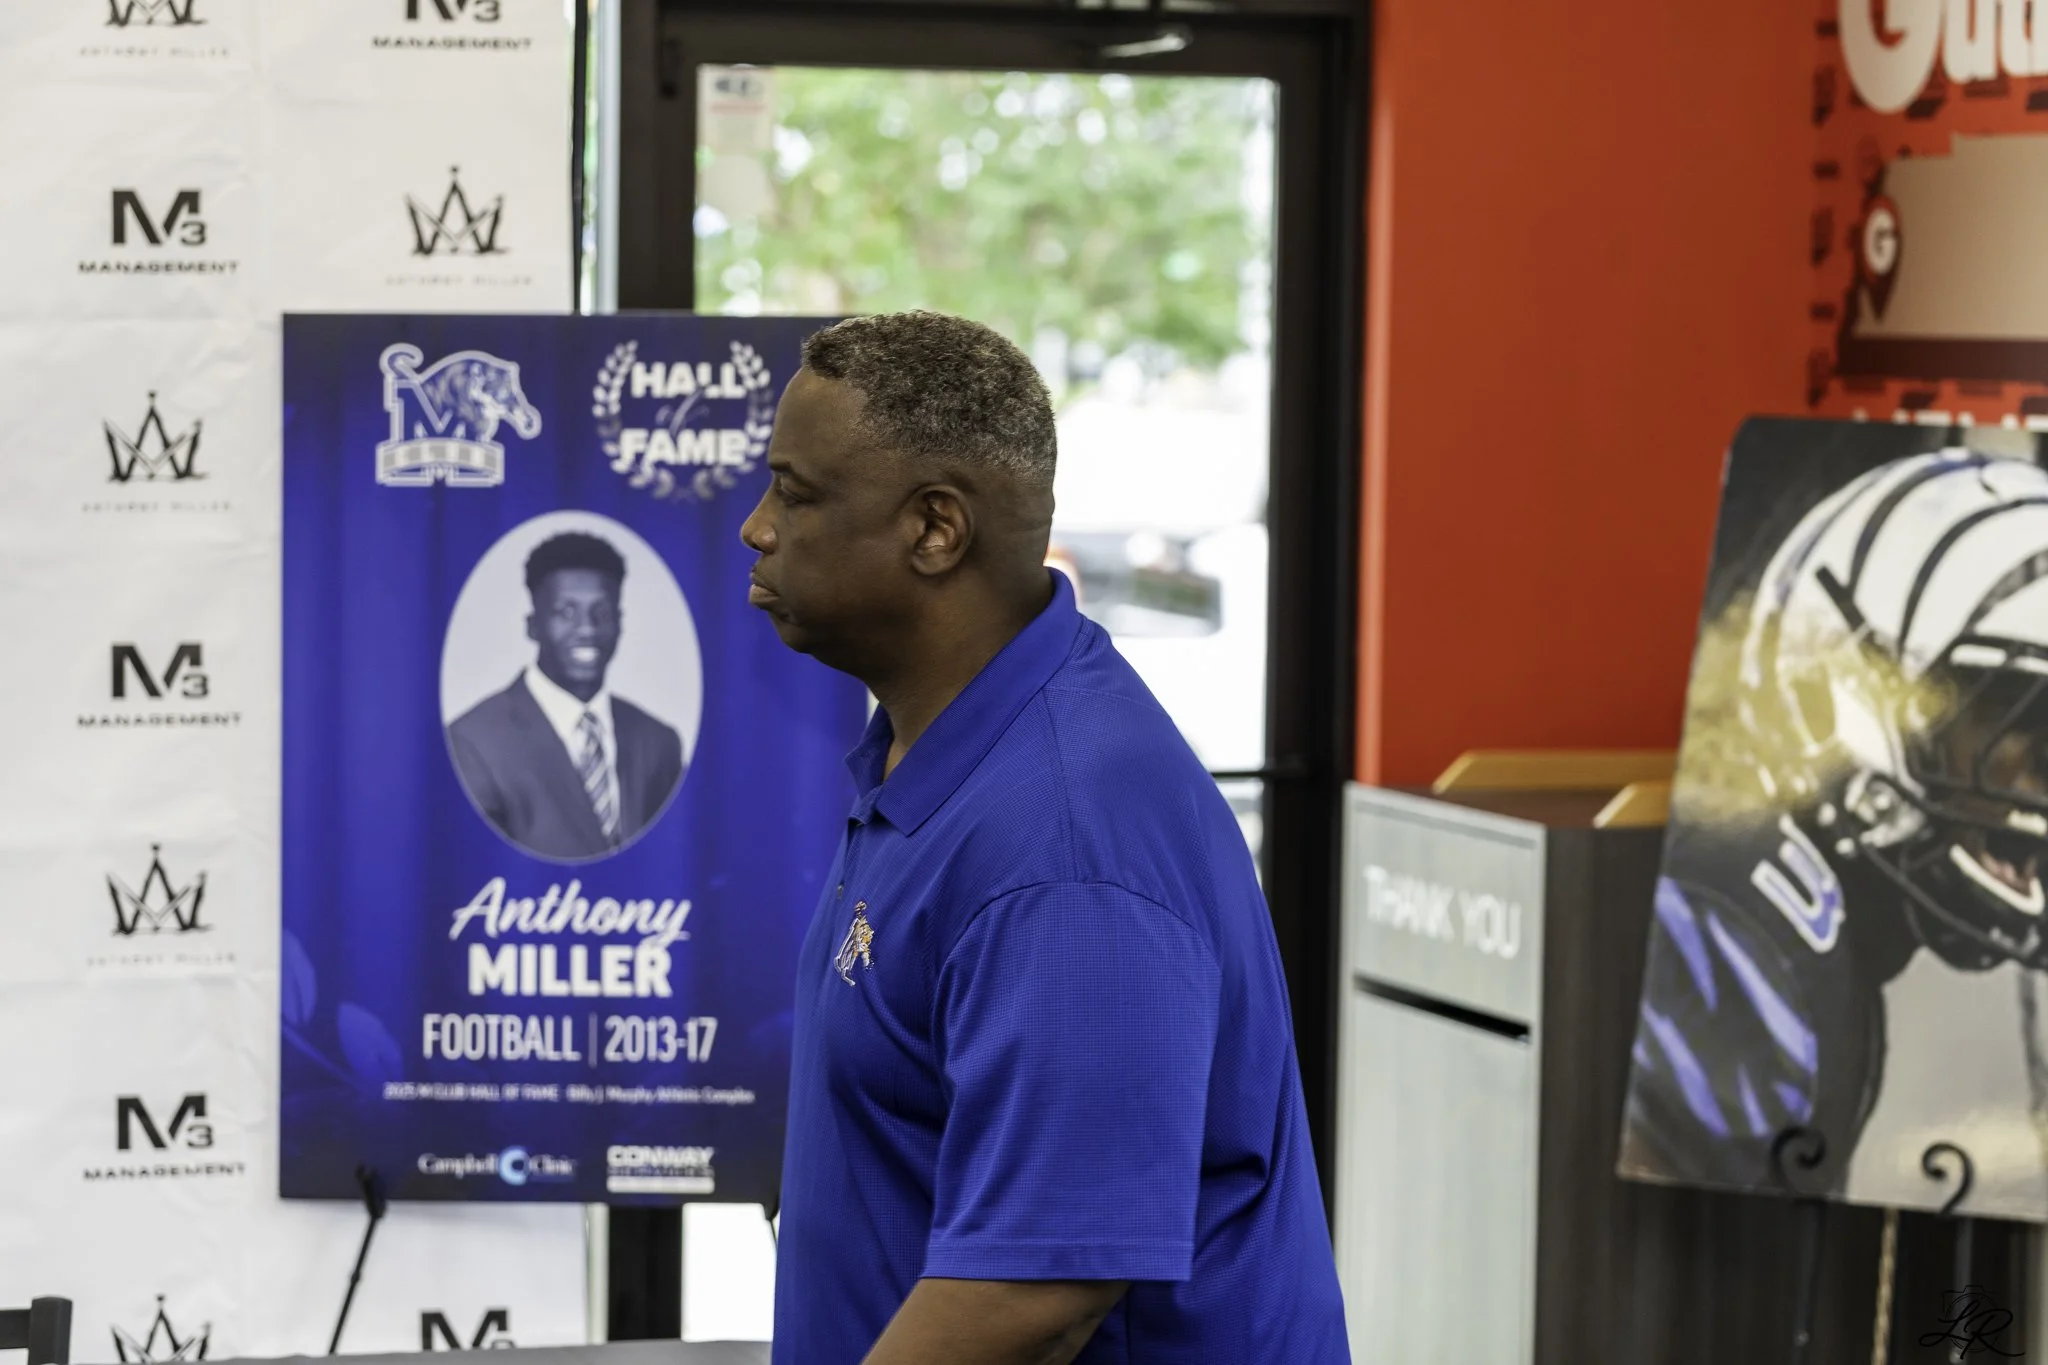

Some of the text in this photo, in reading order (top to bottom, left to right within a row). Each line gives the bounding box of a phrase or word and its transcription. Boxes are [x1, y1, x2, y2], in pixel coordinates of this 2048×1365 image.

[371, 35, 534, 51] MANAGEMENT
[77, 259, 240, 275] MANAGEMENT
[631, 361, 748, 399] HALL
[618, 430, 750, 466] FAME
[76, 711, 242, 728] MANAGEMENT
[449, 876, 692, 947] Anthony
[1458, 888, 1522, 960] YOU
[467, 942, 673, 998] MILLER
[422, 1013, 718, 1063] FOOTBALL 2013-17
[82, 1161, 246, 1180] MANAGEMENT
[606, 1144, 715, 1168] CONWAY
